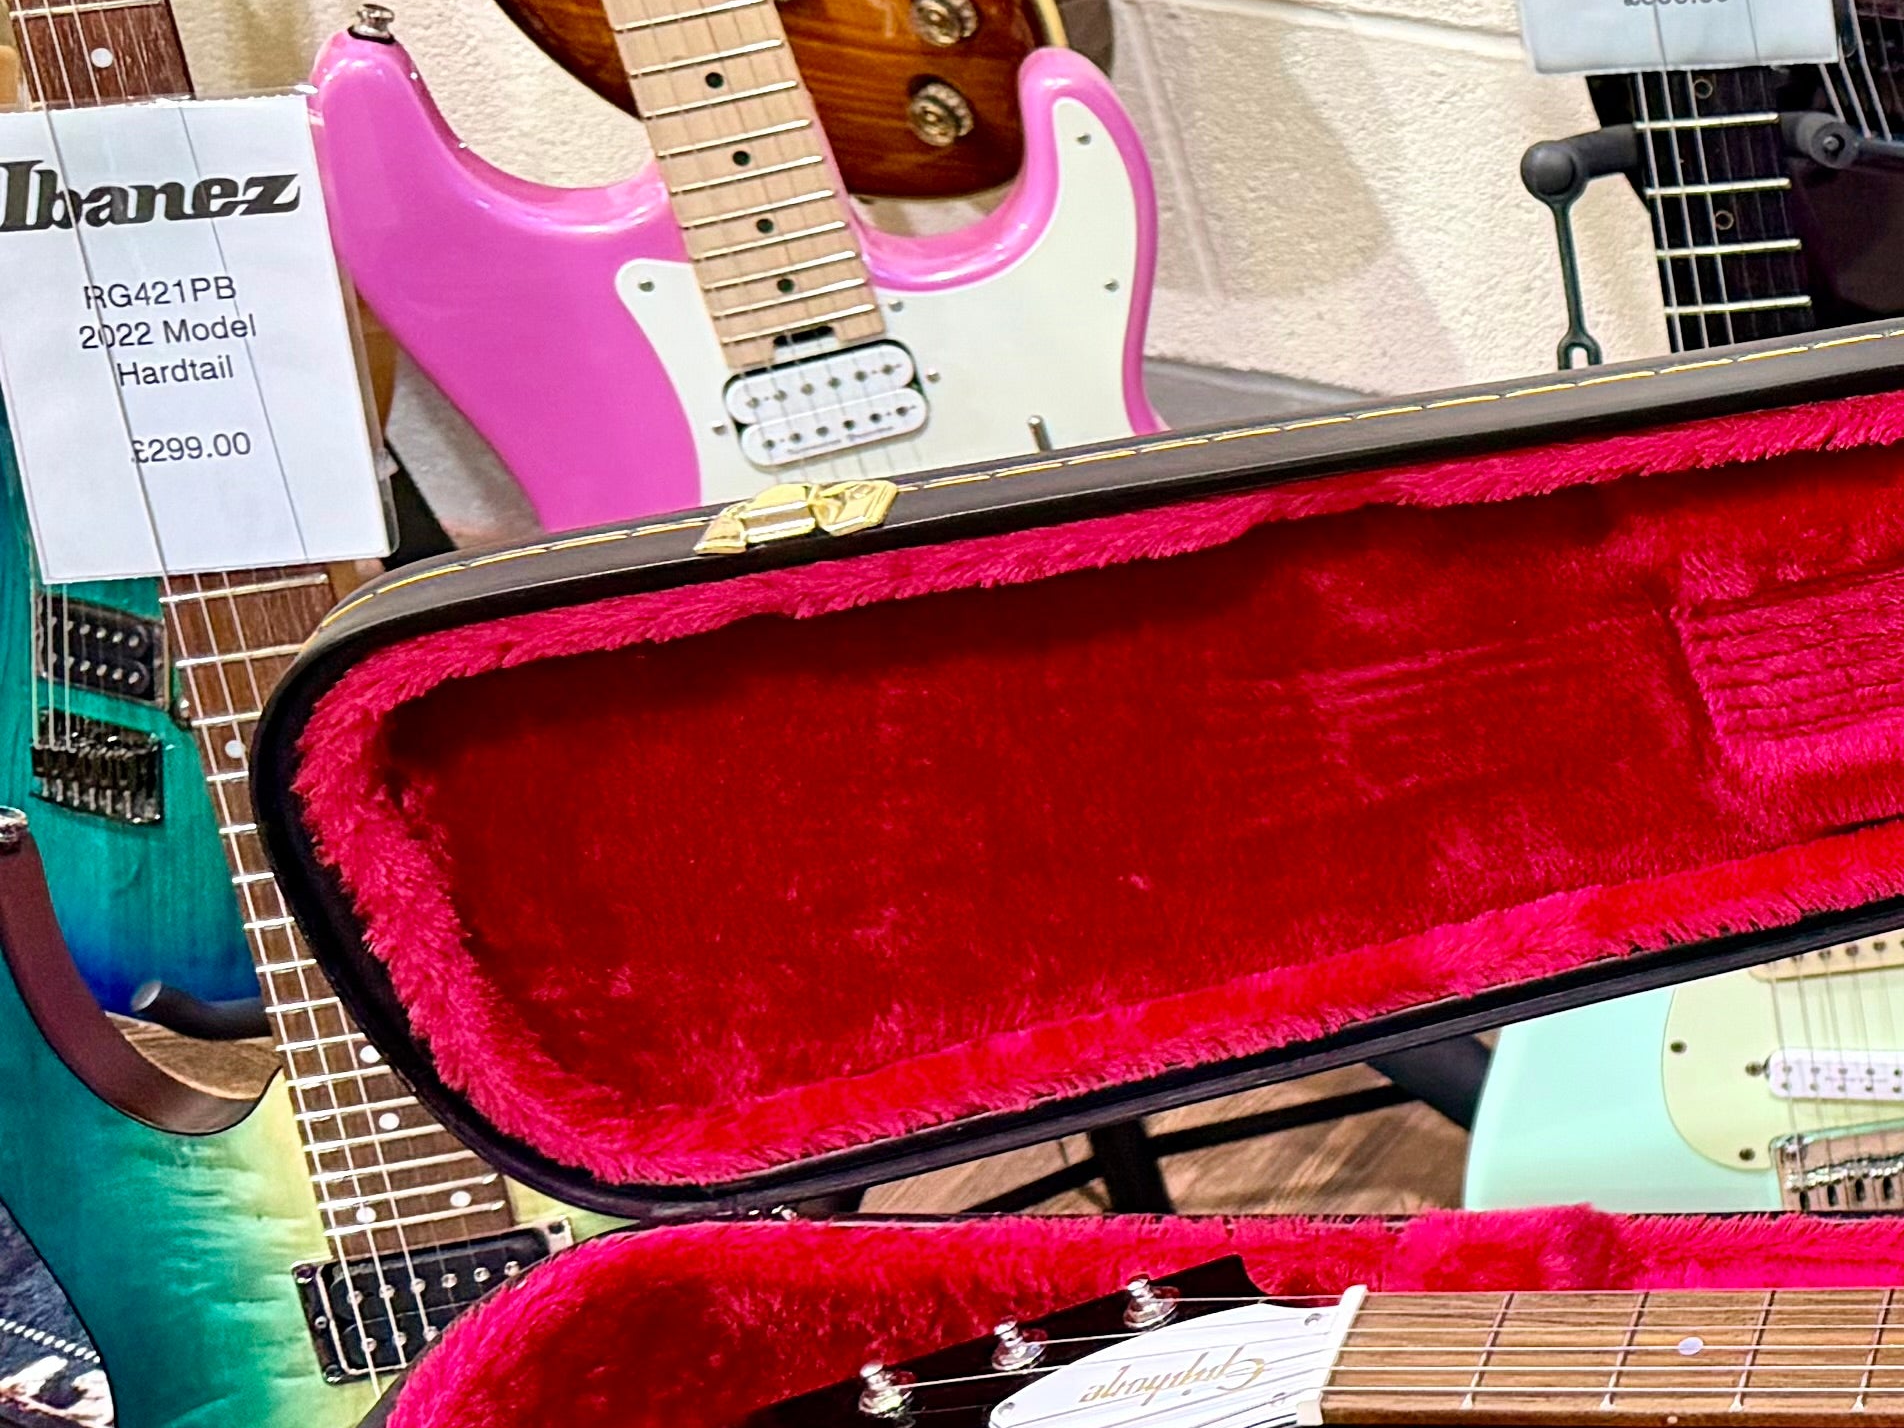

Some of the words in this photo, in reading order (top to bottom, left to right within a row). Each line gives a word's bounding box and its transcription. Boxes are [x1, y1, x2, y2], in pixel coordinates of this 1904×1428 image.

[0, 160, 302, 233] Ibanez
[84, 275, 237, 310] RG421PB
[79, 321, 153, 350] 2022
[164, 314, 257, 345] Model
[116, 356, 234, 387] Hardtail
[131, 431, 252, 463] £299.00
[1079, 1345, 1266, 1407] Epiphone
